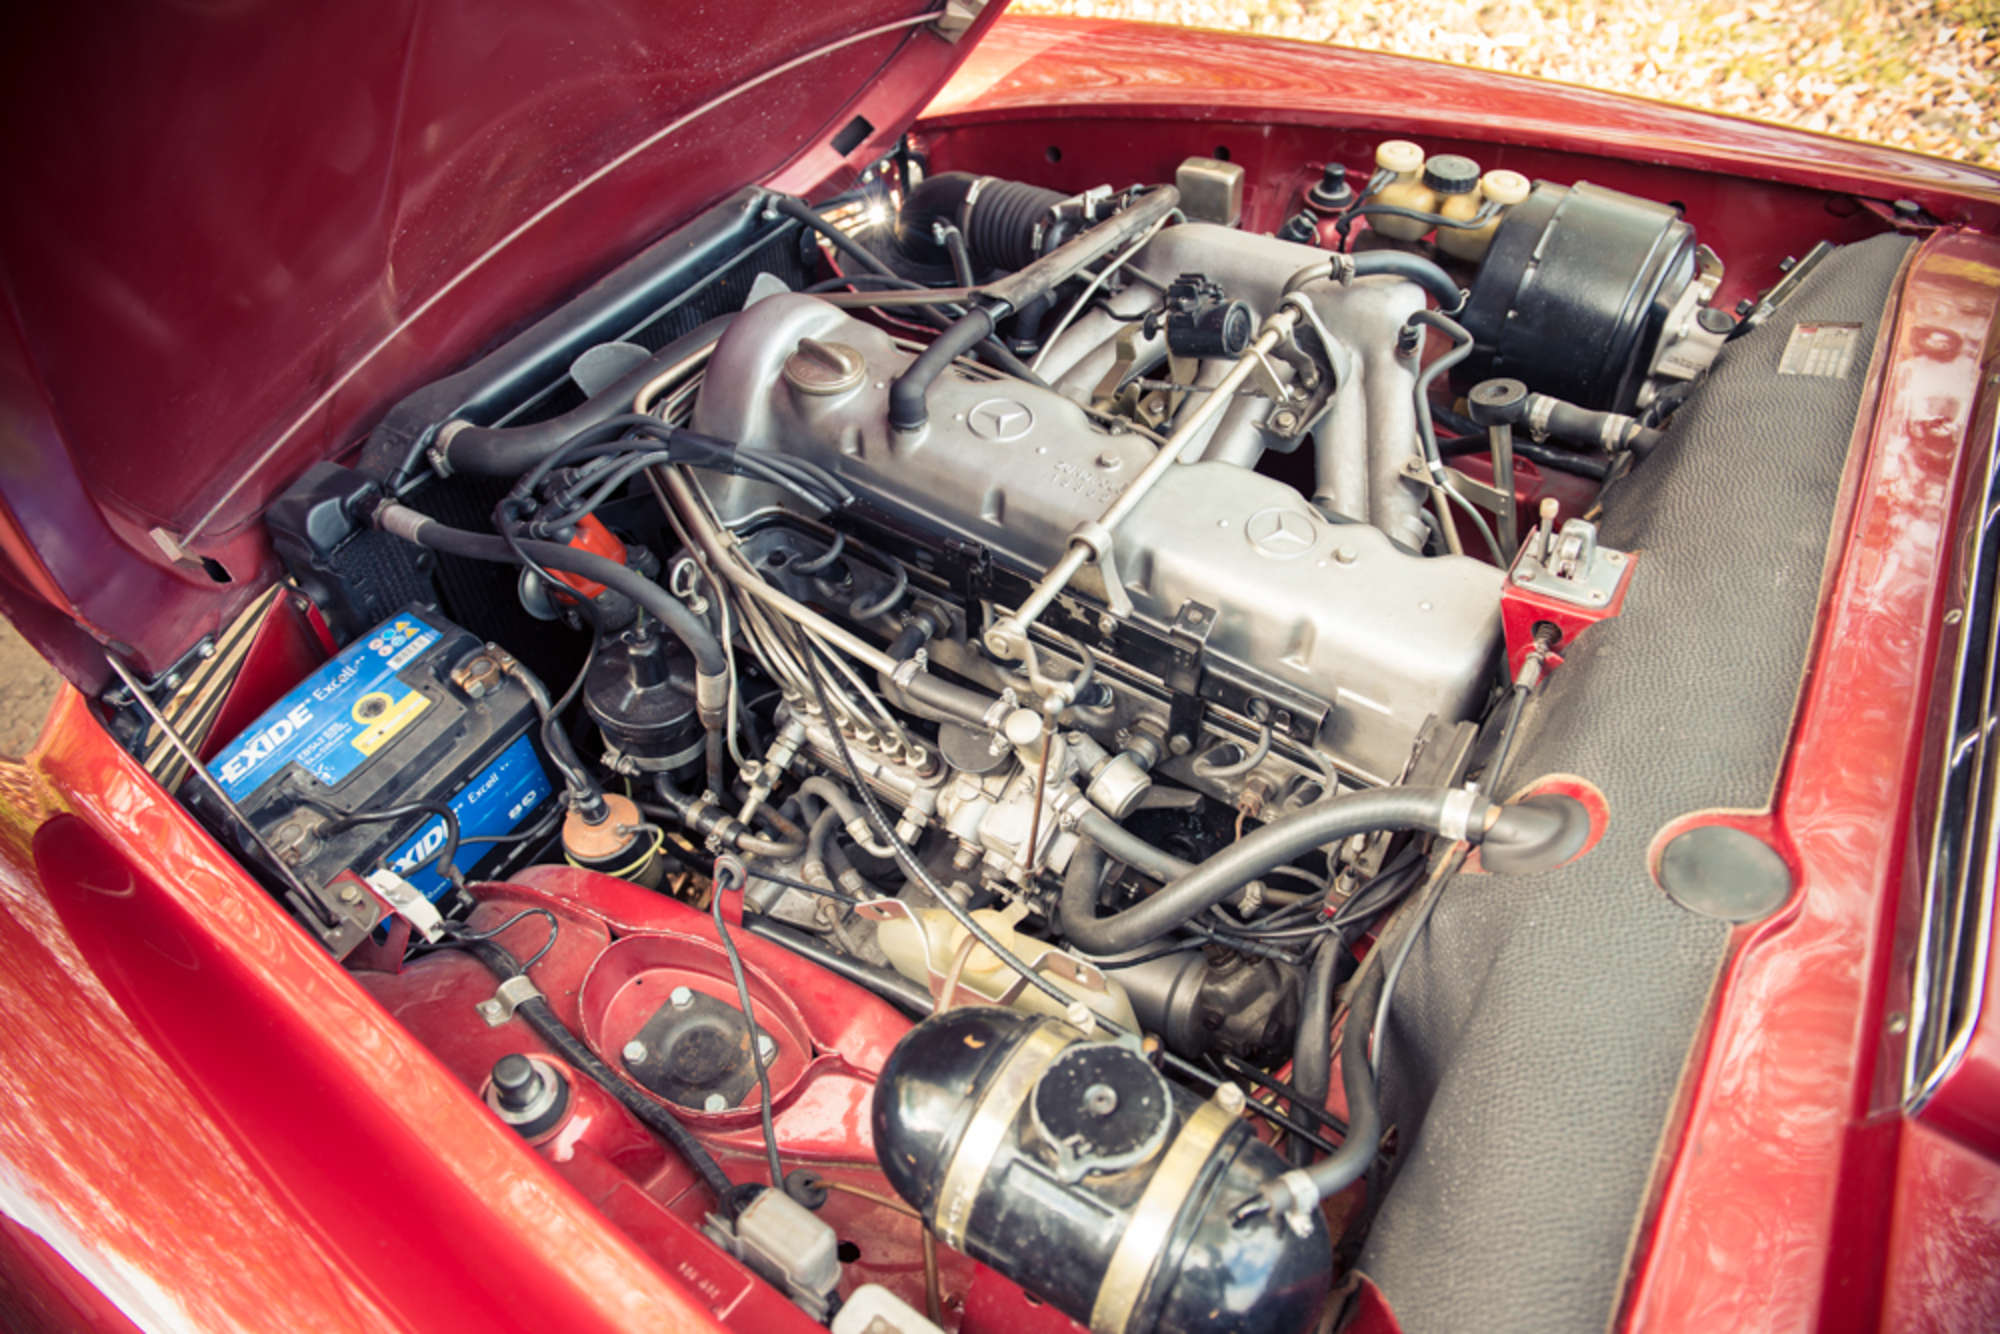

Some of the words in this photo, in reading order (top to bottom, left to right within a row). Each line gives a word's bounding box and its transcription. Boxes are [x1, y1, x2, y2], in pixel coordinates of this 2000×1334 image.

[221, 702, 314, 784] EXIDE
[312, 665, 358, 701] Excell
[390, 806, 462, 872] XID
[467, 772, 499, 804] Excell
